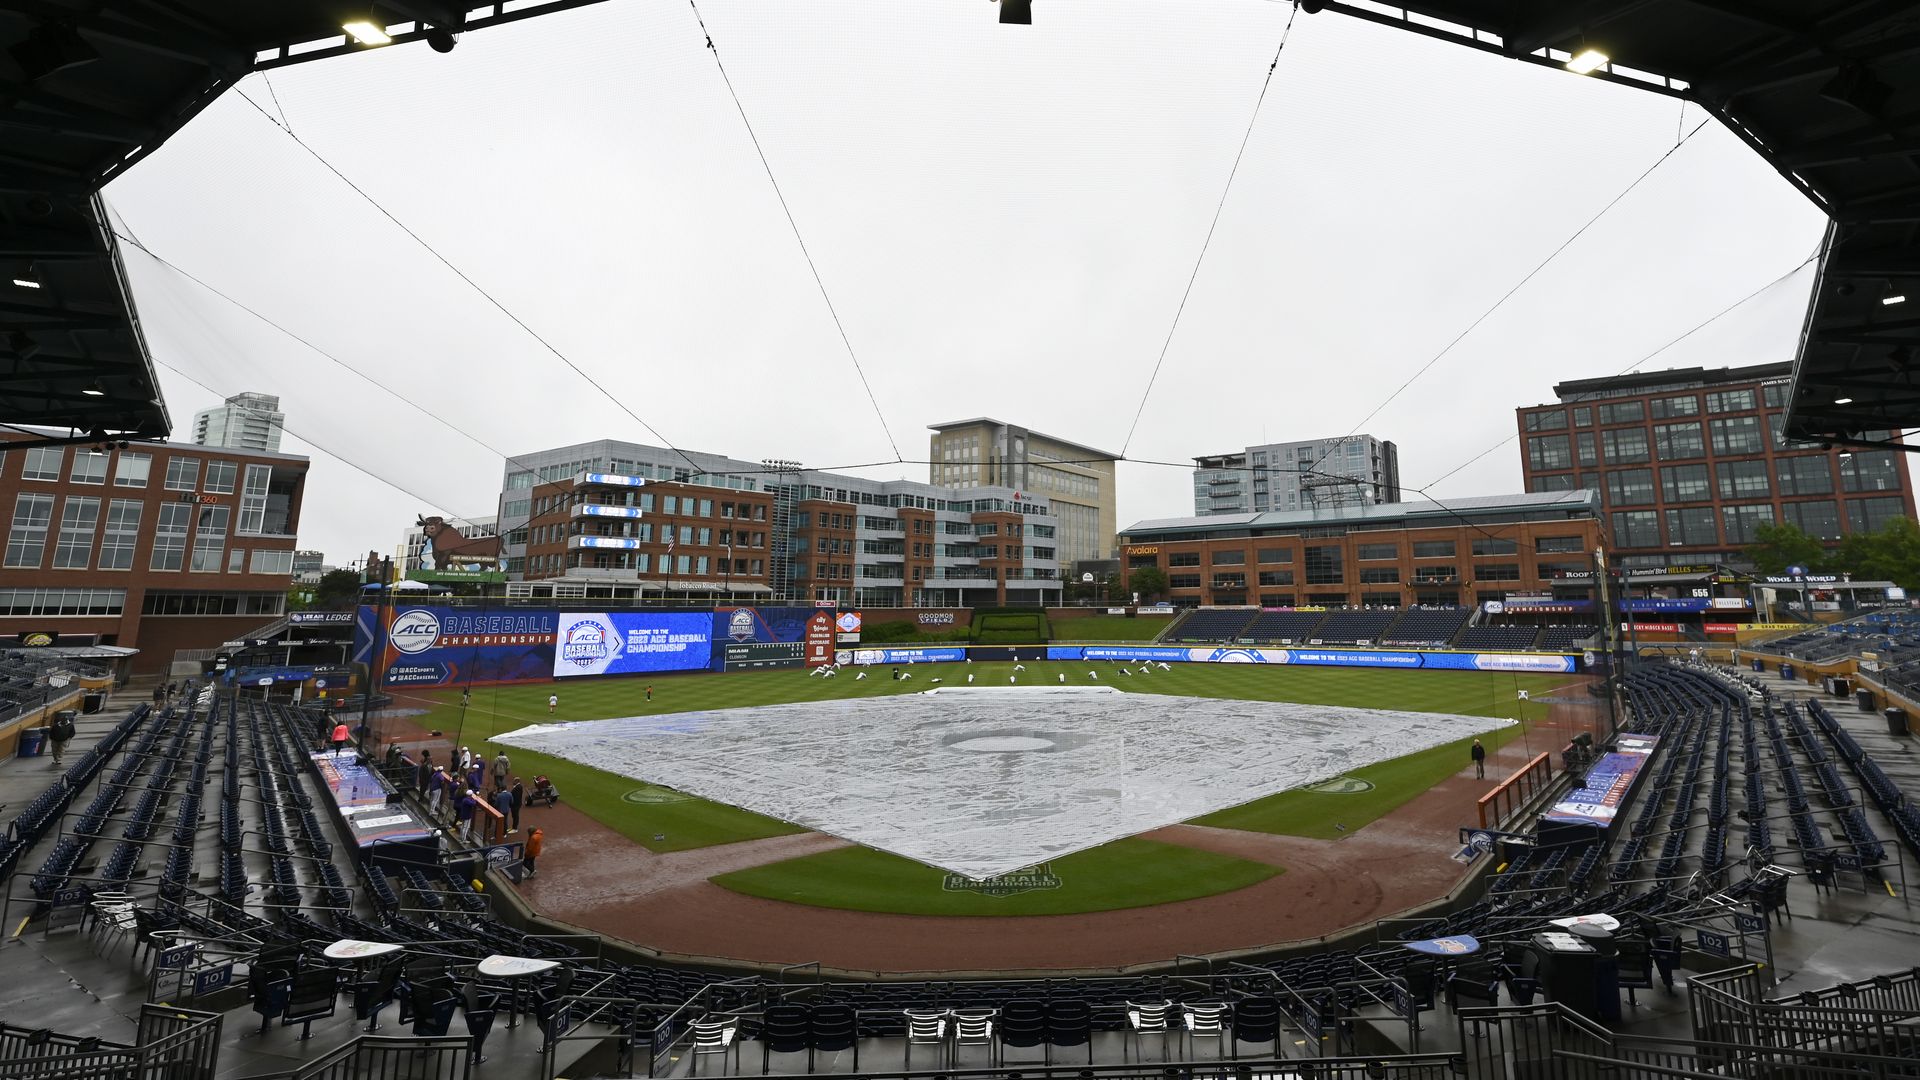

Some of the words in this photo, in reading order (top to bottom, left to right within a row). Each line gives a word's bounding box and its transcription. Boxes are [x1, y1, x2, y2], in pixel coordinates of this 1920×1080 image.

[200, 496, 218, 504] 360
[1126, 546, 1158, 554] Avalara
[396, 625, 437, 634] ACC
[444, 616, 551, 634] BASEBALL
[442, 636, 551, 645] CHAMPIONSHIP
[628, 636, 648, 644] 2023
[650, 635, 666, 643] ACC
[669, 634, 707, 642] BASEBALL
[627, 644, 686, 653] CHAMPIONSHIP
[60, 891, 80, 901] 103
[1702, 935, 1722, 948] 102
[204, 971, 224, 984] 101
[1306, 1013, 1316, 1029] 100
[658, 1026, 670, 1044] 100
